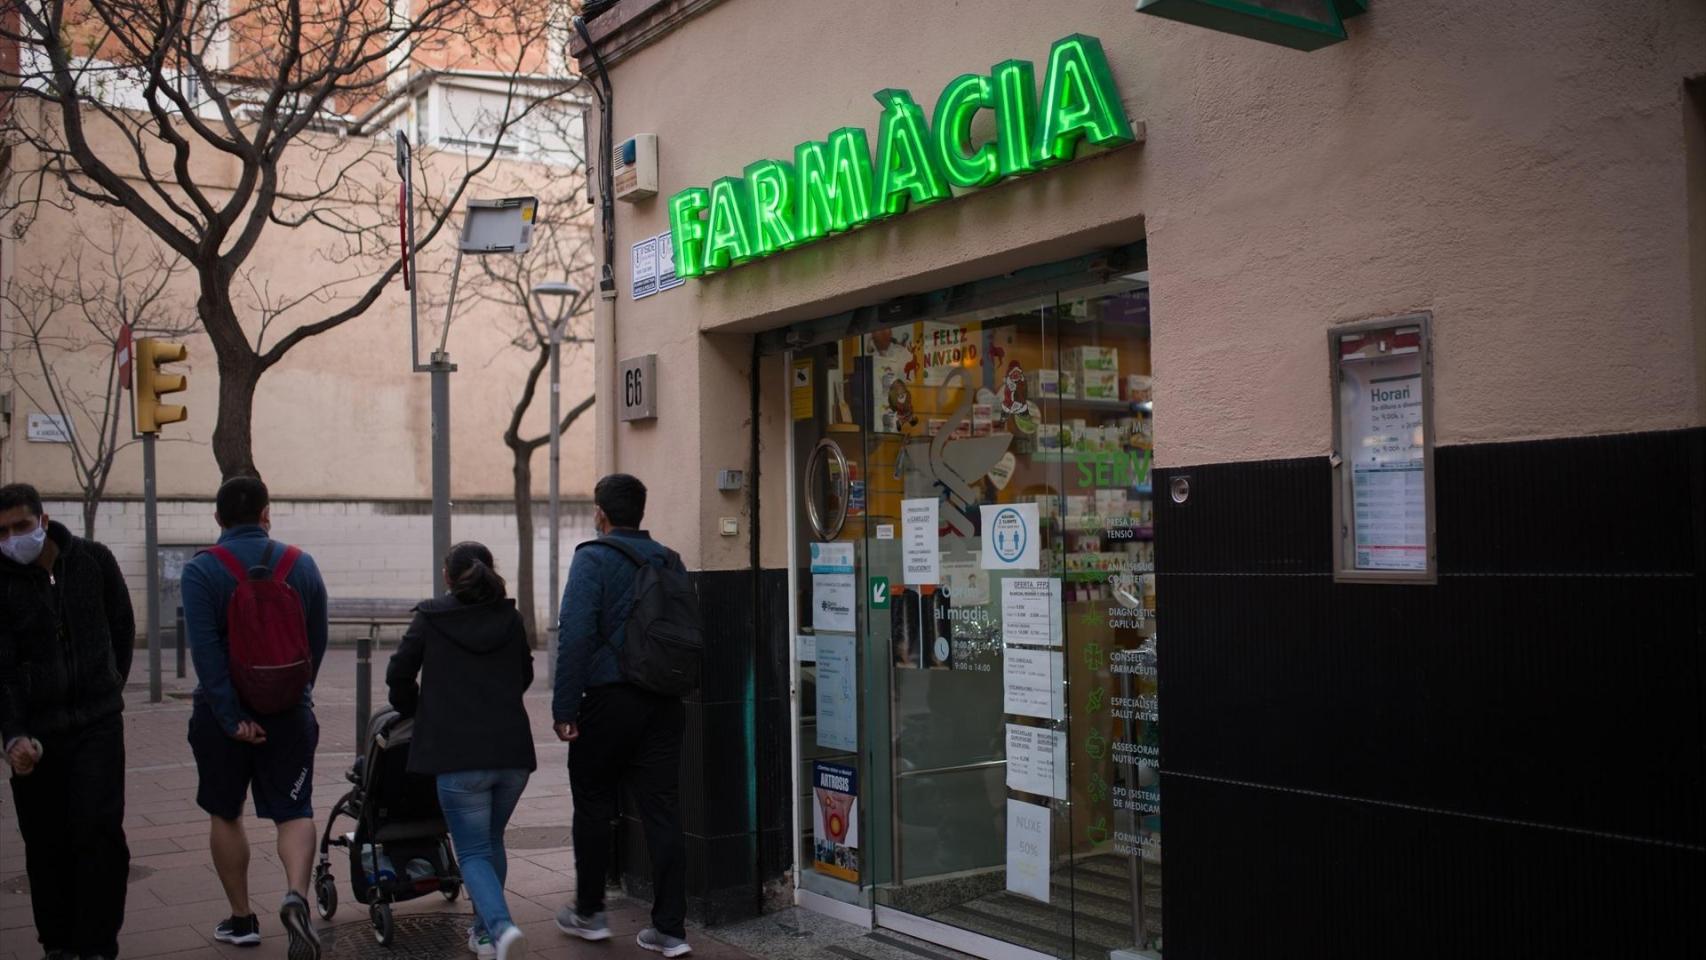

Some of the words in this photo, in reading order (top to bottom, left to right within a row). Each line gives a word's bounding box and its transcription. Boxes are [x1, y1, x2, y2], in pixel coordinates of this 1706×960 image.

[669, 33, 1134, 279] FARMÀCIA
[934, 327, 968, 348] FELIZ
[923, 344, 977, 369] NAVIDAD
[626, 367, 642, 407] 66
[1076, 448, 1152, 488] SERV
[933, 604, 945, 620] al
[947, 606, 989, 624] migdia
[820, 771, 850, 793] ARTROSIS
